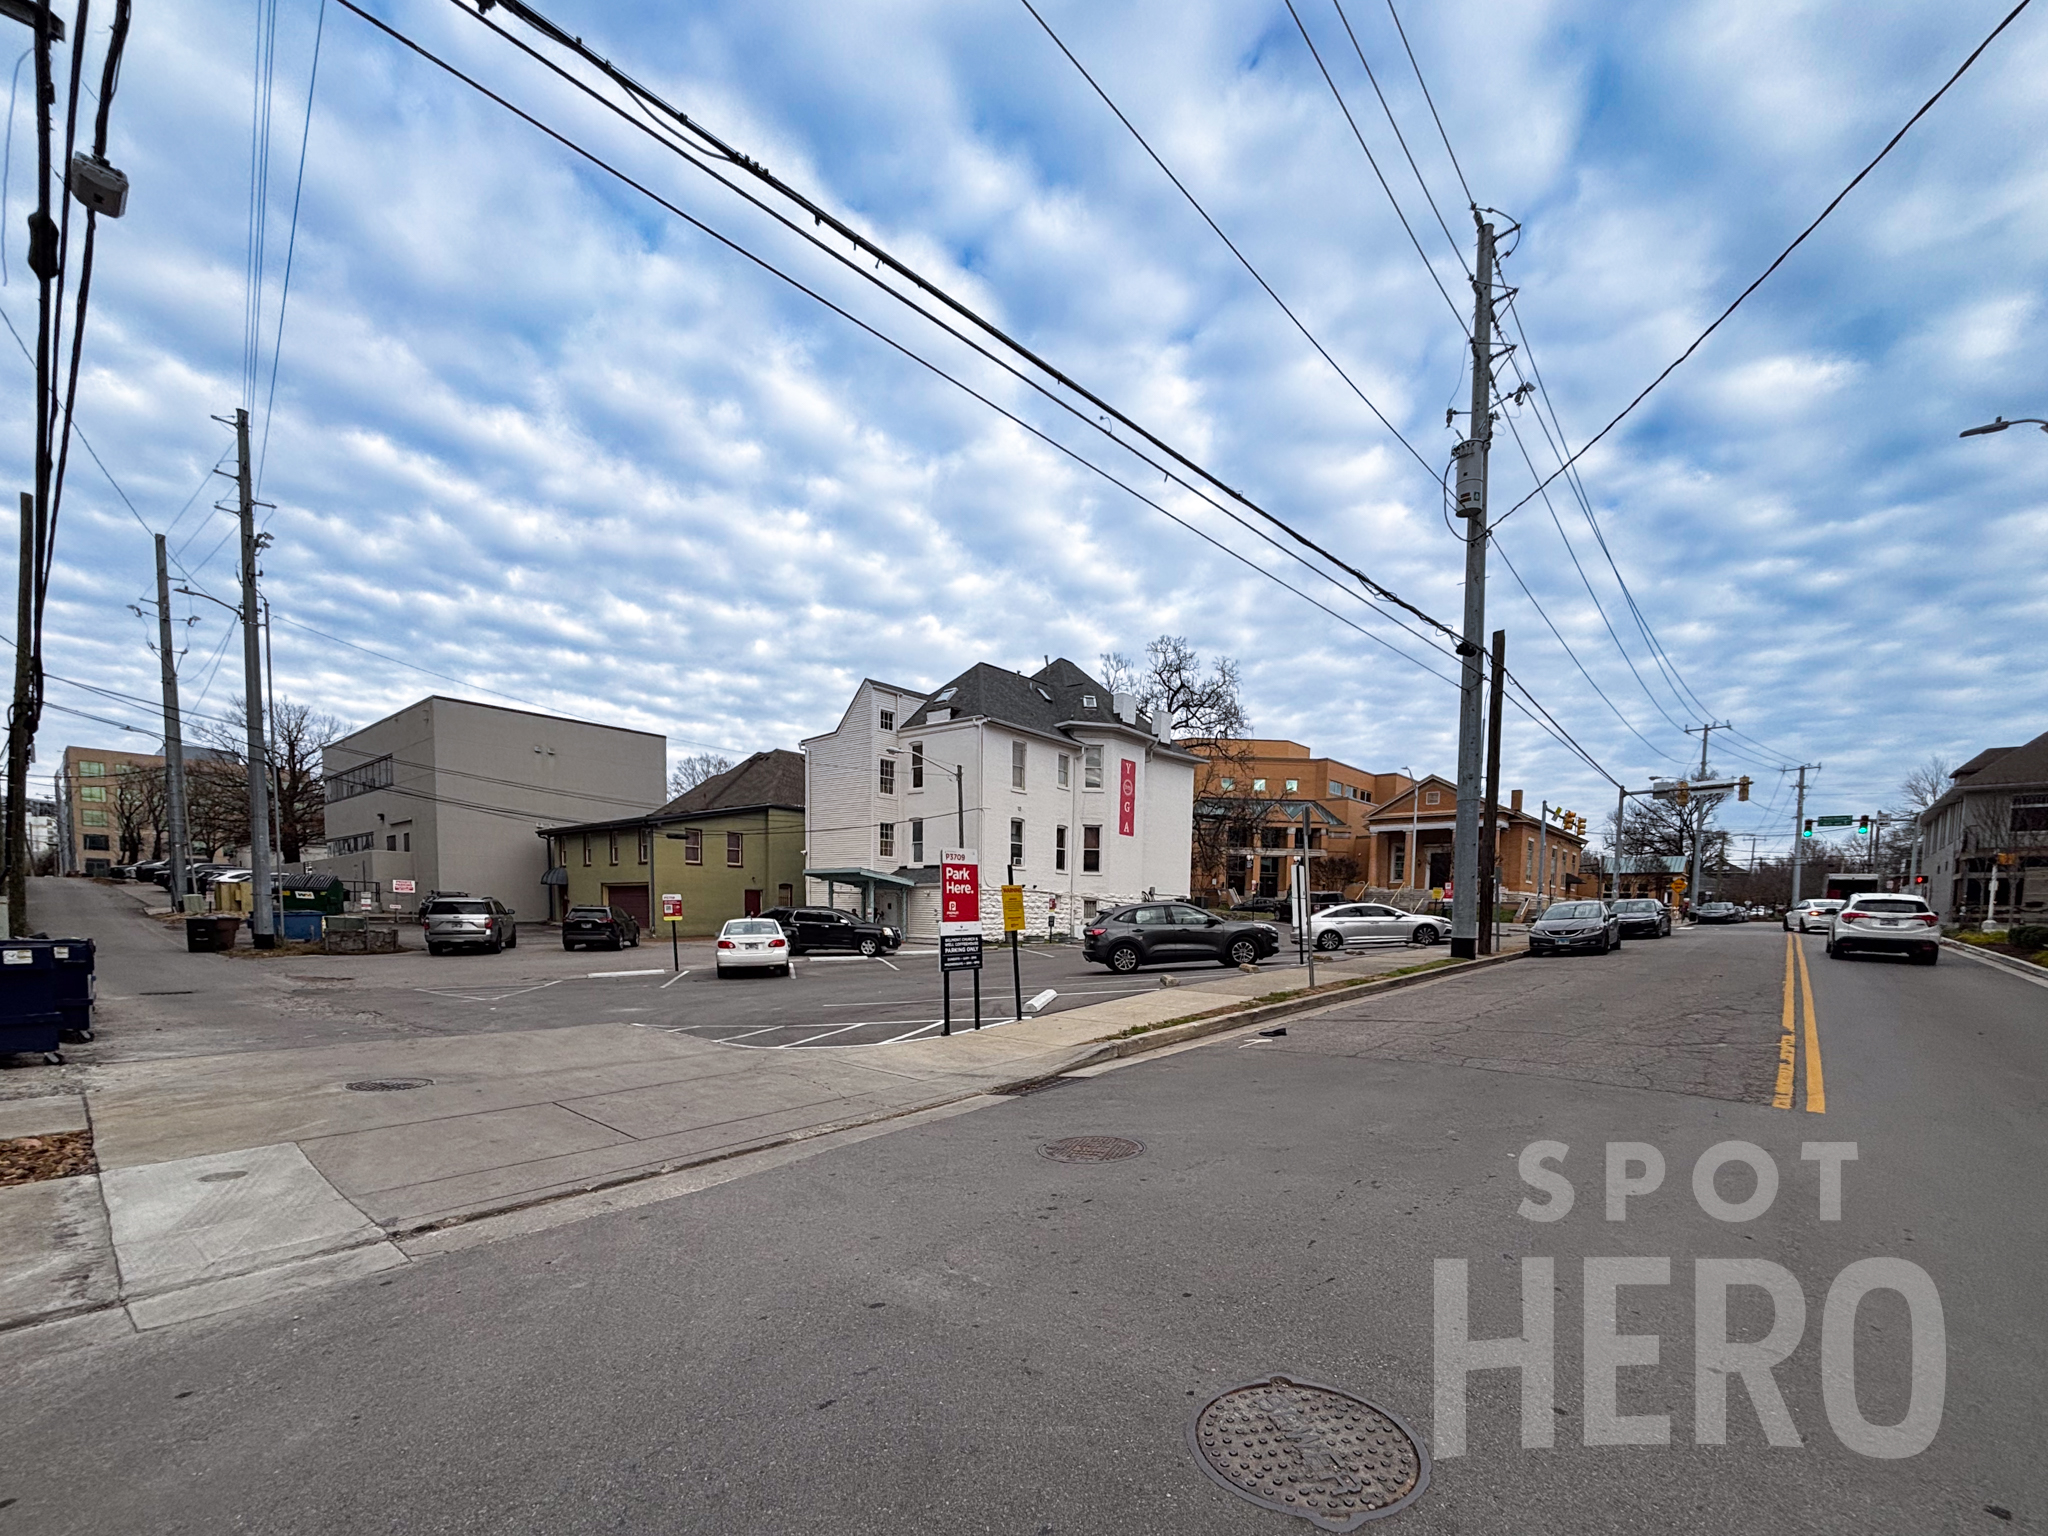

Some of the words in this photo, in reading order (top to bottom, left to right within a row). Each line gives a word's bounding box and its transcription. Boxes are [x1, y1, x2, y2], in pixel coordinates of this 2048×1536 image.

[1122, 763, 1133, 833] YOGA
[945, 853, 966, 861] P3709
[946, 867, 970, 880] Park
[946, 881, 974, 894] Here.
